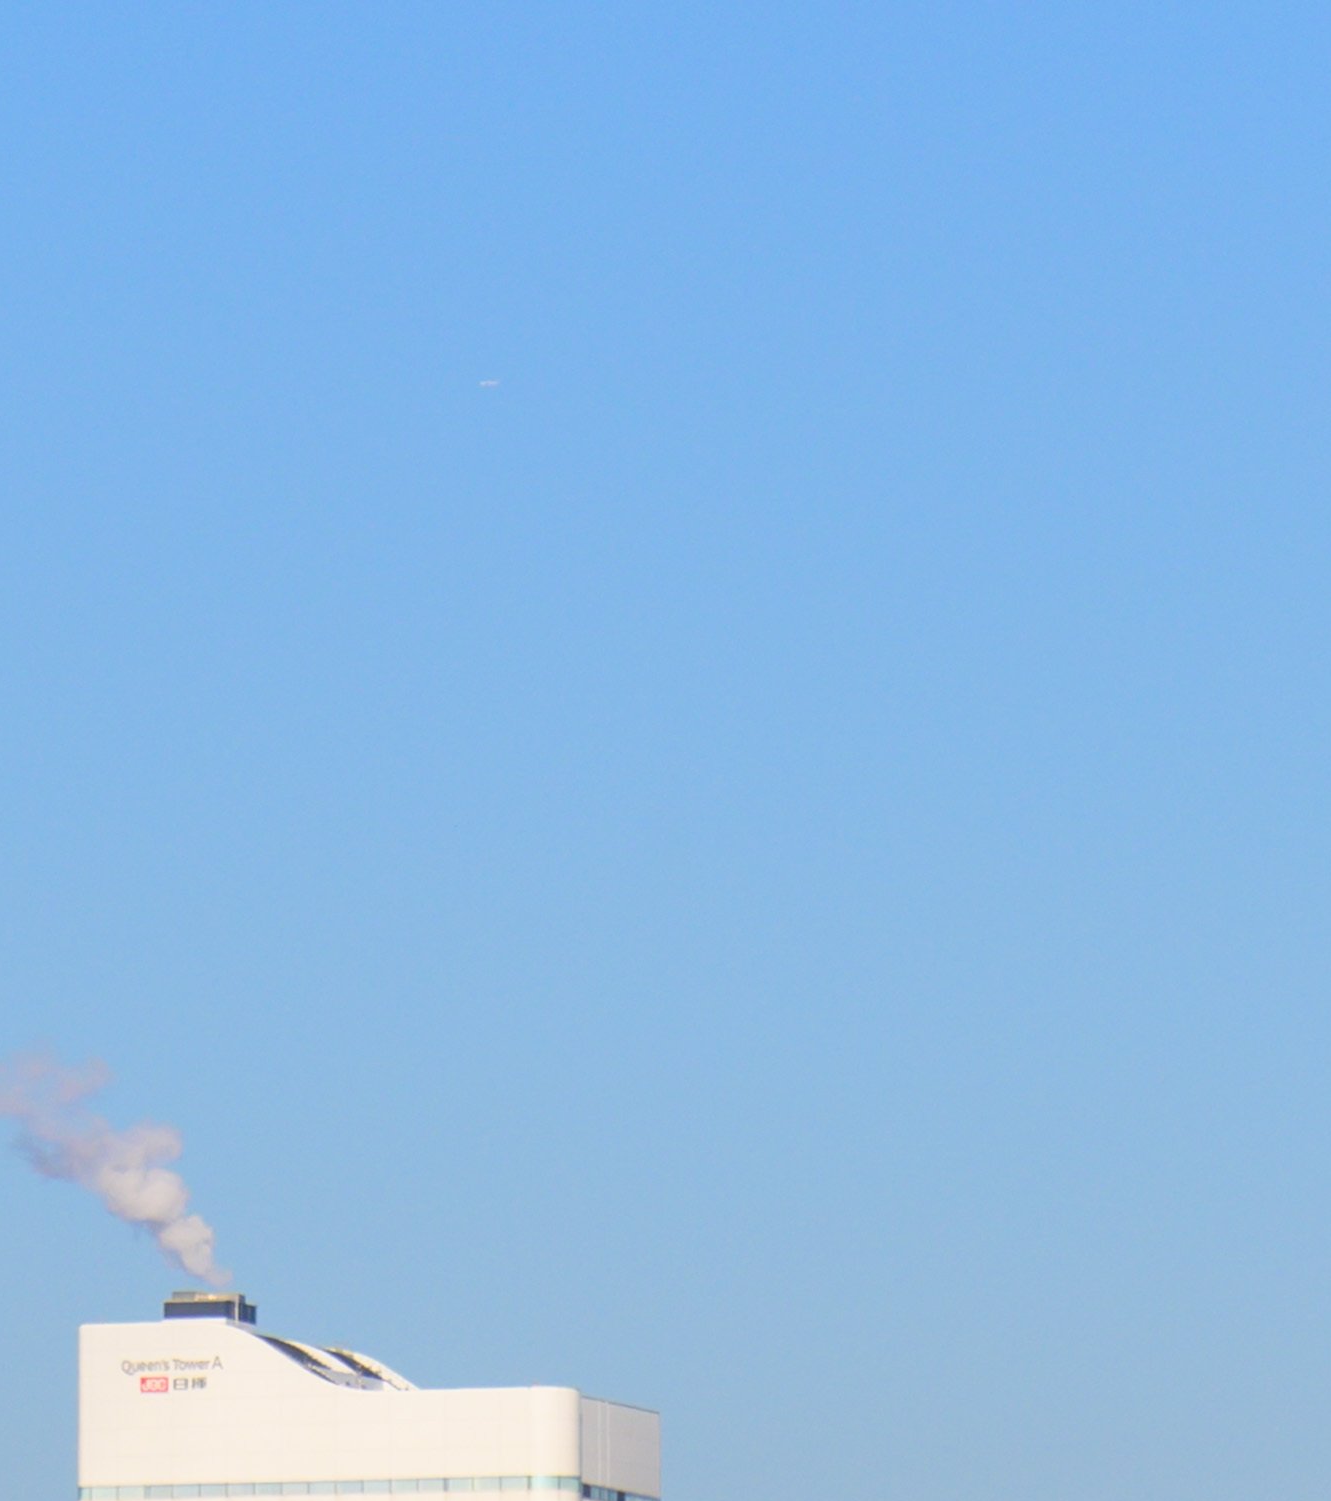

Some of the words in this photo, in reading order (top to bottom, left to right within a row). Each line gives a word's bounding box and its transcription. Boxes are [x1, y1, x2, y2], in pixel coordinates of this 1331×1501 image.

[121, 1360, 170, 1375] Queen's
[172, 1358, 210, 1371] Tower
[212, 1355, 224, 1370] A
